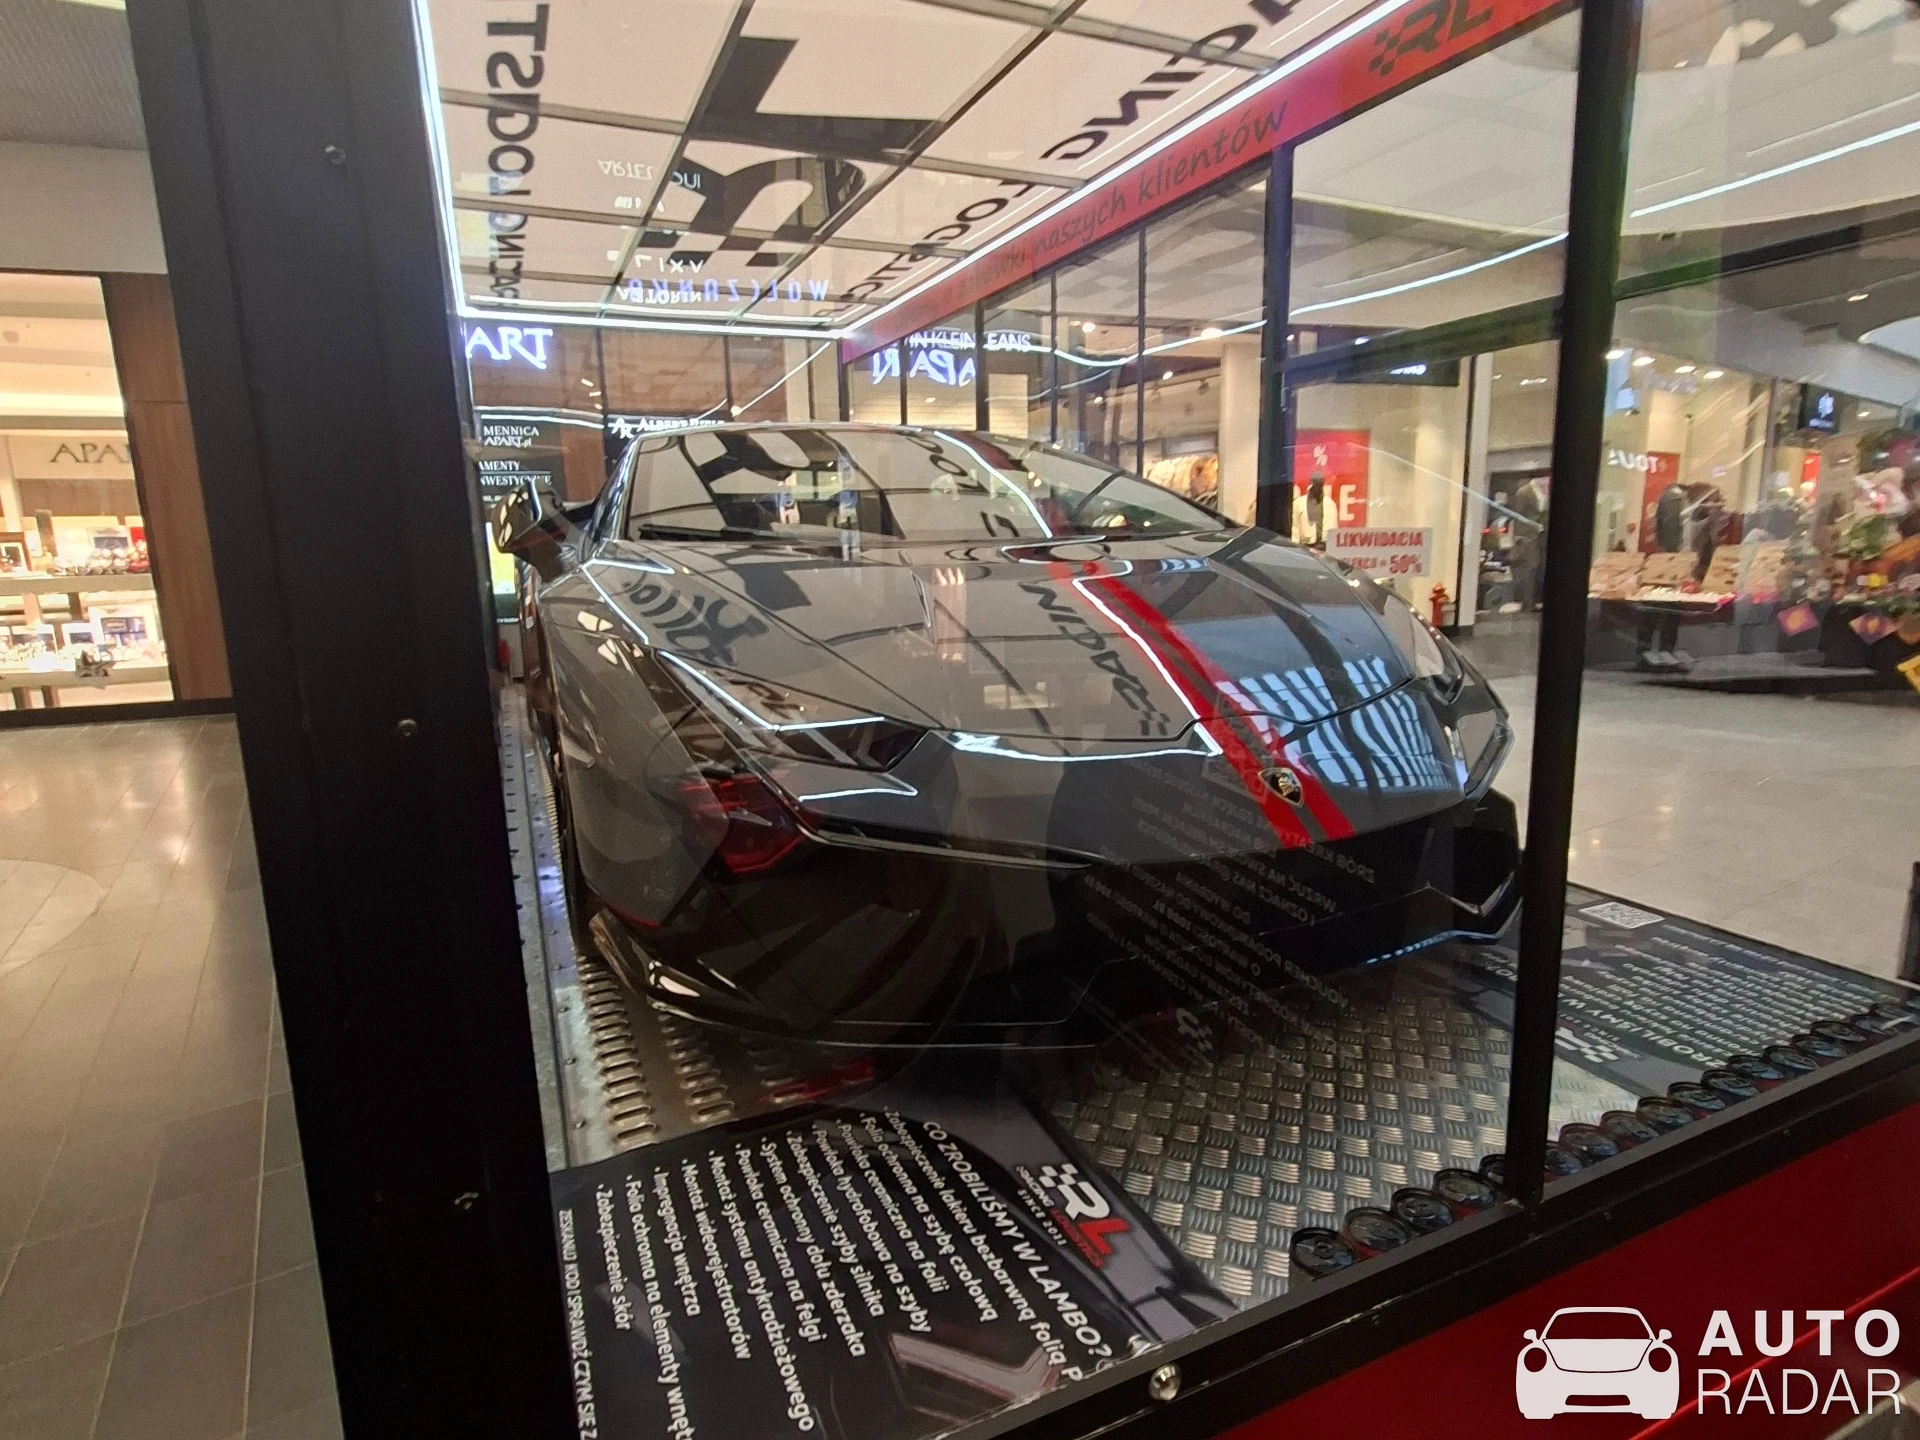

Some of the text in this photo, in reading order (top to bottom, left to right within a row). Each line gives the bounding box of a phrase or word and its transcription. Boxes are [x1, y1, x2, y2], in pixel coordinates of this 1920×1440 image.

[1033, 185, 1126, 254] naszych
[1137, 100, 1290, 201] klientów
[466, 326, 553, 370] ART
[987, 333, 1031, 351] EANS
[49, 442, 132, 464] APA
[483, 425, 540, 437] MENNICA
[565, 1264, 580, 1289] KOD
[596, 1190, 633, 1329] Zabezpieczenie skór
[653, 1173, 700, 1316] Impregnacja wnętrza
[682, 1164, 751, 1358] Montaż wideorejestratorów
[736, 1149, 827, 1341] Powłoka ceramiczna na felgi
[760, 1143, 865, 1356] System ochronny dołu zderzaka
[787, 1136, 884, 1316] Zabezpieczenie szyby silnika
[813, 1130, 931, 1331] Powłoka hydrofobowa na szyby
[838, 1125, 949, 1292] Powłoka ceramiczna na folii
[861, 1117, 998, 1321] Folia ochronna na szybę czołową
[885, 1111, 945, 1188] Zabezpieczenie
[939, 1190, 976, 1234] lakieru
[970, 1235, 1036, 1321] bezbarwną
[1030, 1322, 1066, 1365] folią
[923, 1121, 1113, 1357] CO ZROBILIŚMY W LAMBO?
[1017, 1188, 1068, 1246] SINCE 2011
[567, 1295, 592, 1359] SPRAWDŹ
[626, 1181, 695, 1440] Folia ochronna na elementy wnęt
[709, 1156, 814, 1430] Montaż systemu antykradzieżowego
[574, 1360, 593, 1402] CZYM
